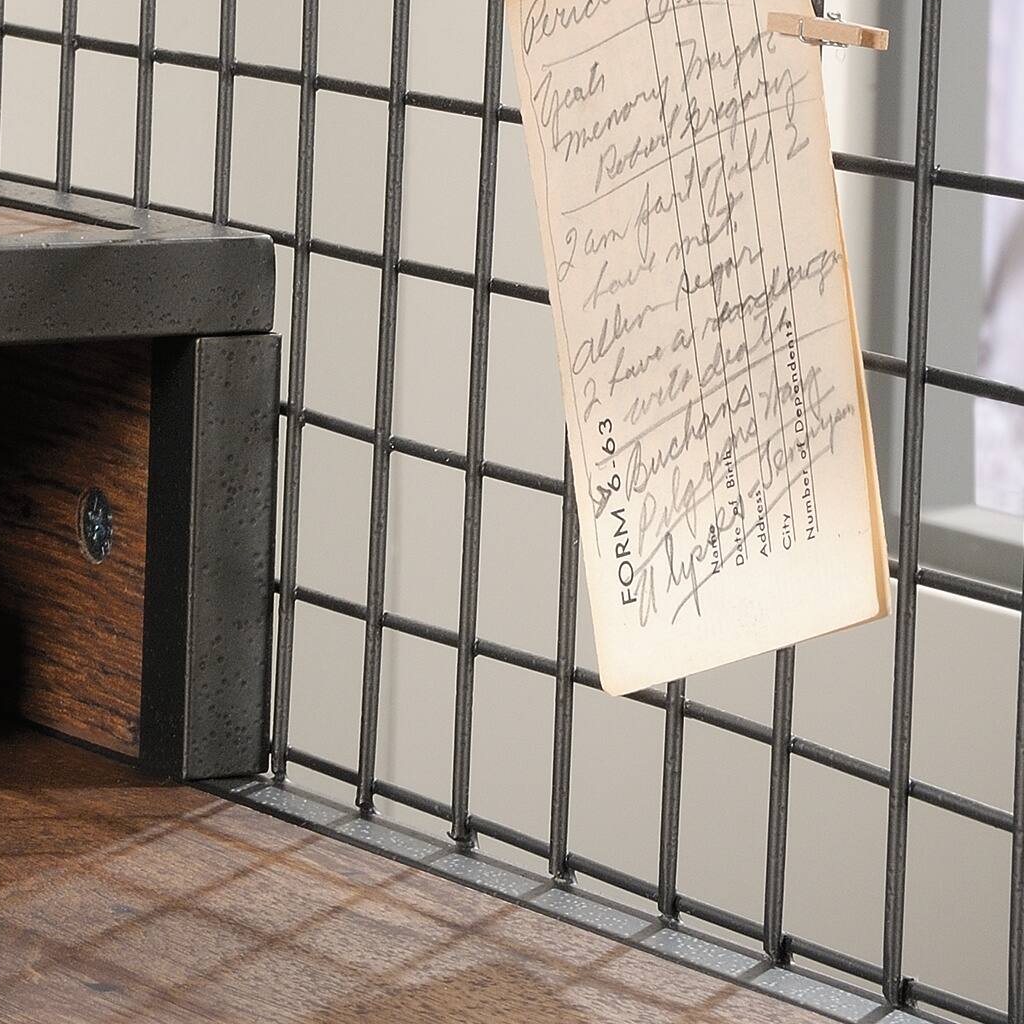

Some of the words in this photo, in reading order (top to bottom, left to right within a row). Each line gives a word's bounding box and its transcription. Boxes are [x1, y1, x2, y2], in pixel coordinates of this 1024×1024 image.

[784, 319, 806, 433] Dependents
[598, 417, 622, 492] 6-63
[722, 449, 736, 489] Birth
[799, 439, 809, 461] of
[754, 489, 769, 558] Address
[781, 512, 793, 551] City
[799, 468, 816, 541] Number
[610, 507, 637, 606] FORM
[733, 526, 746, 566] Date
